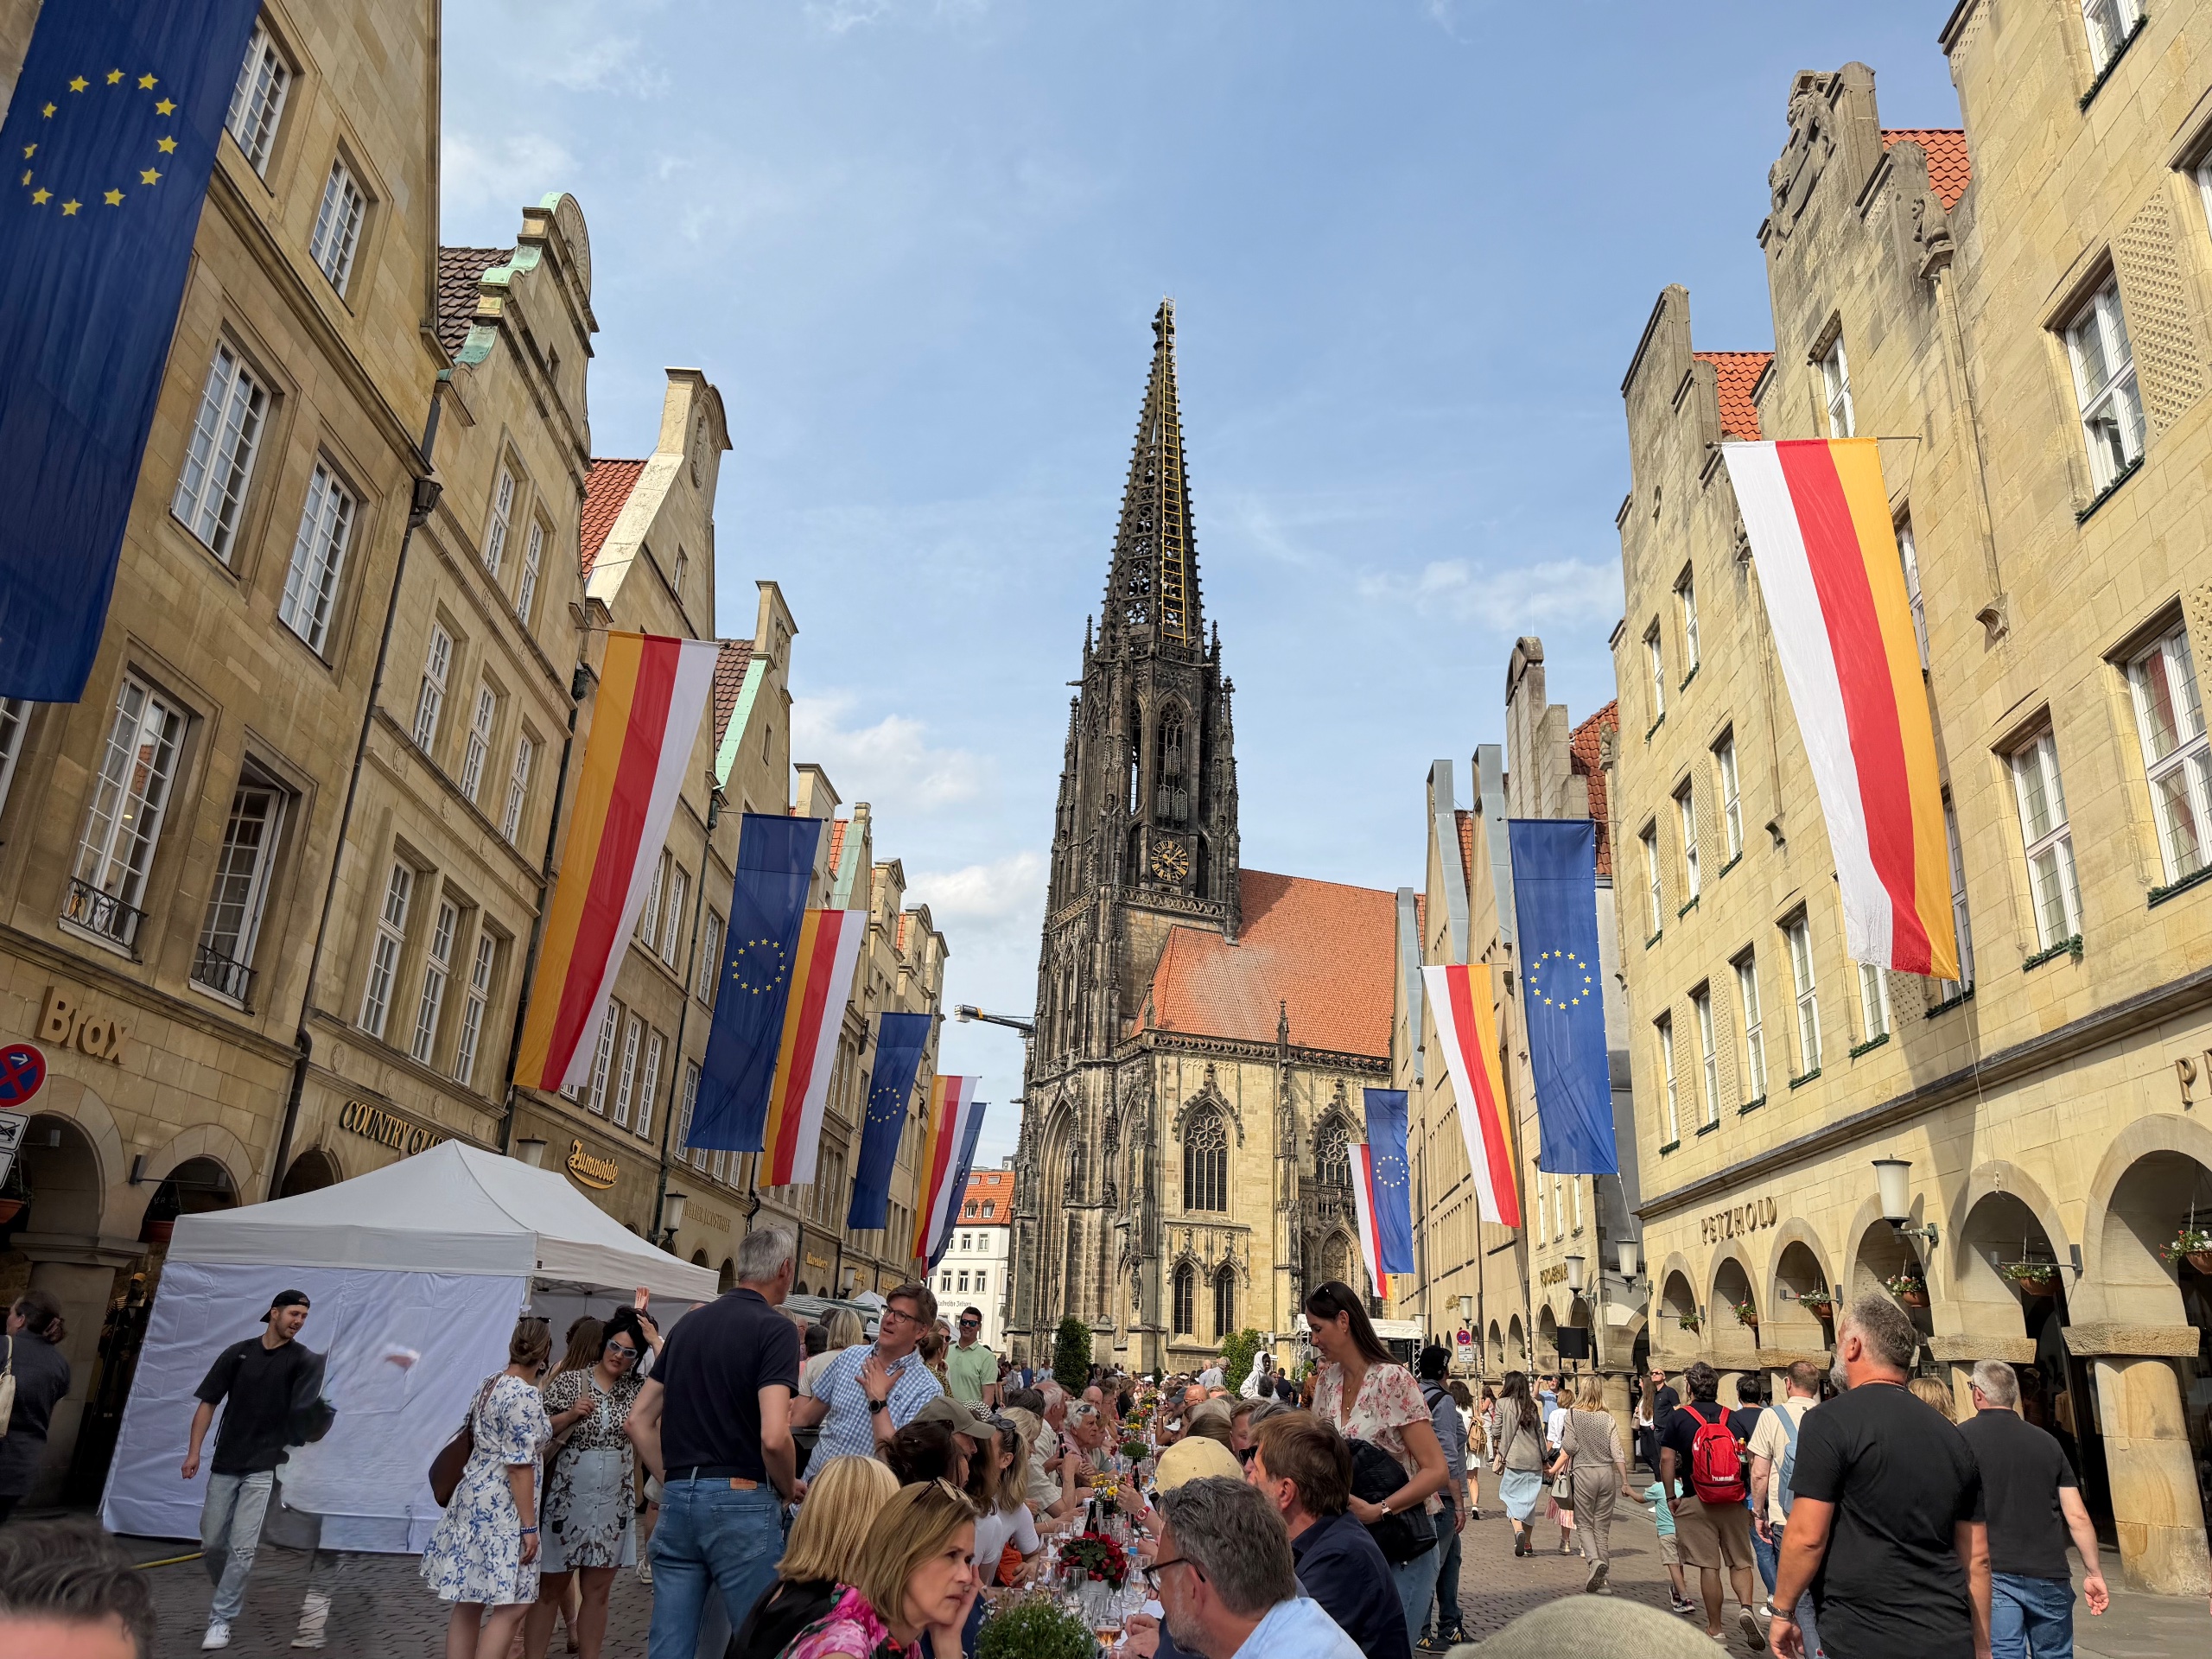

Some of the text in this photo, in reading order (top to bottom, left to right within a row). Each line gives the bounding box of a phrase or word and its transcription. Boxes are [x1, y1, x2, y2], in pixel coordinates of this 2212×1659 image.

[35, 986, 131, 1064] Brax
[340, 1100, 410, 1150] COUNTRY
[1701, 1196, 1777, 1244] PETZHOLD
